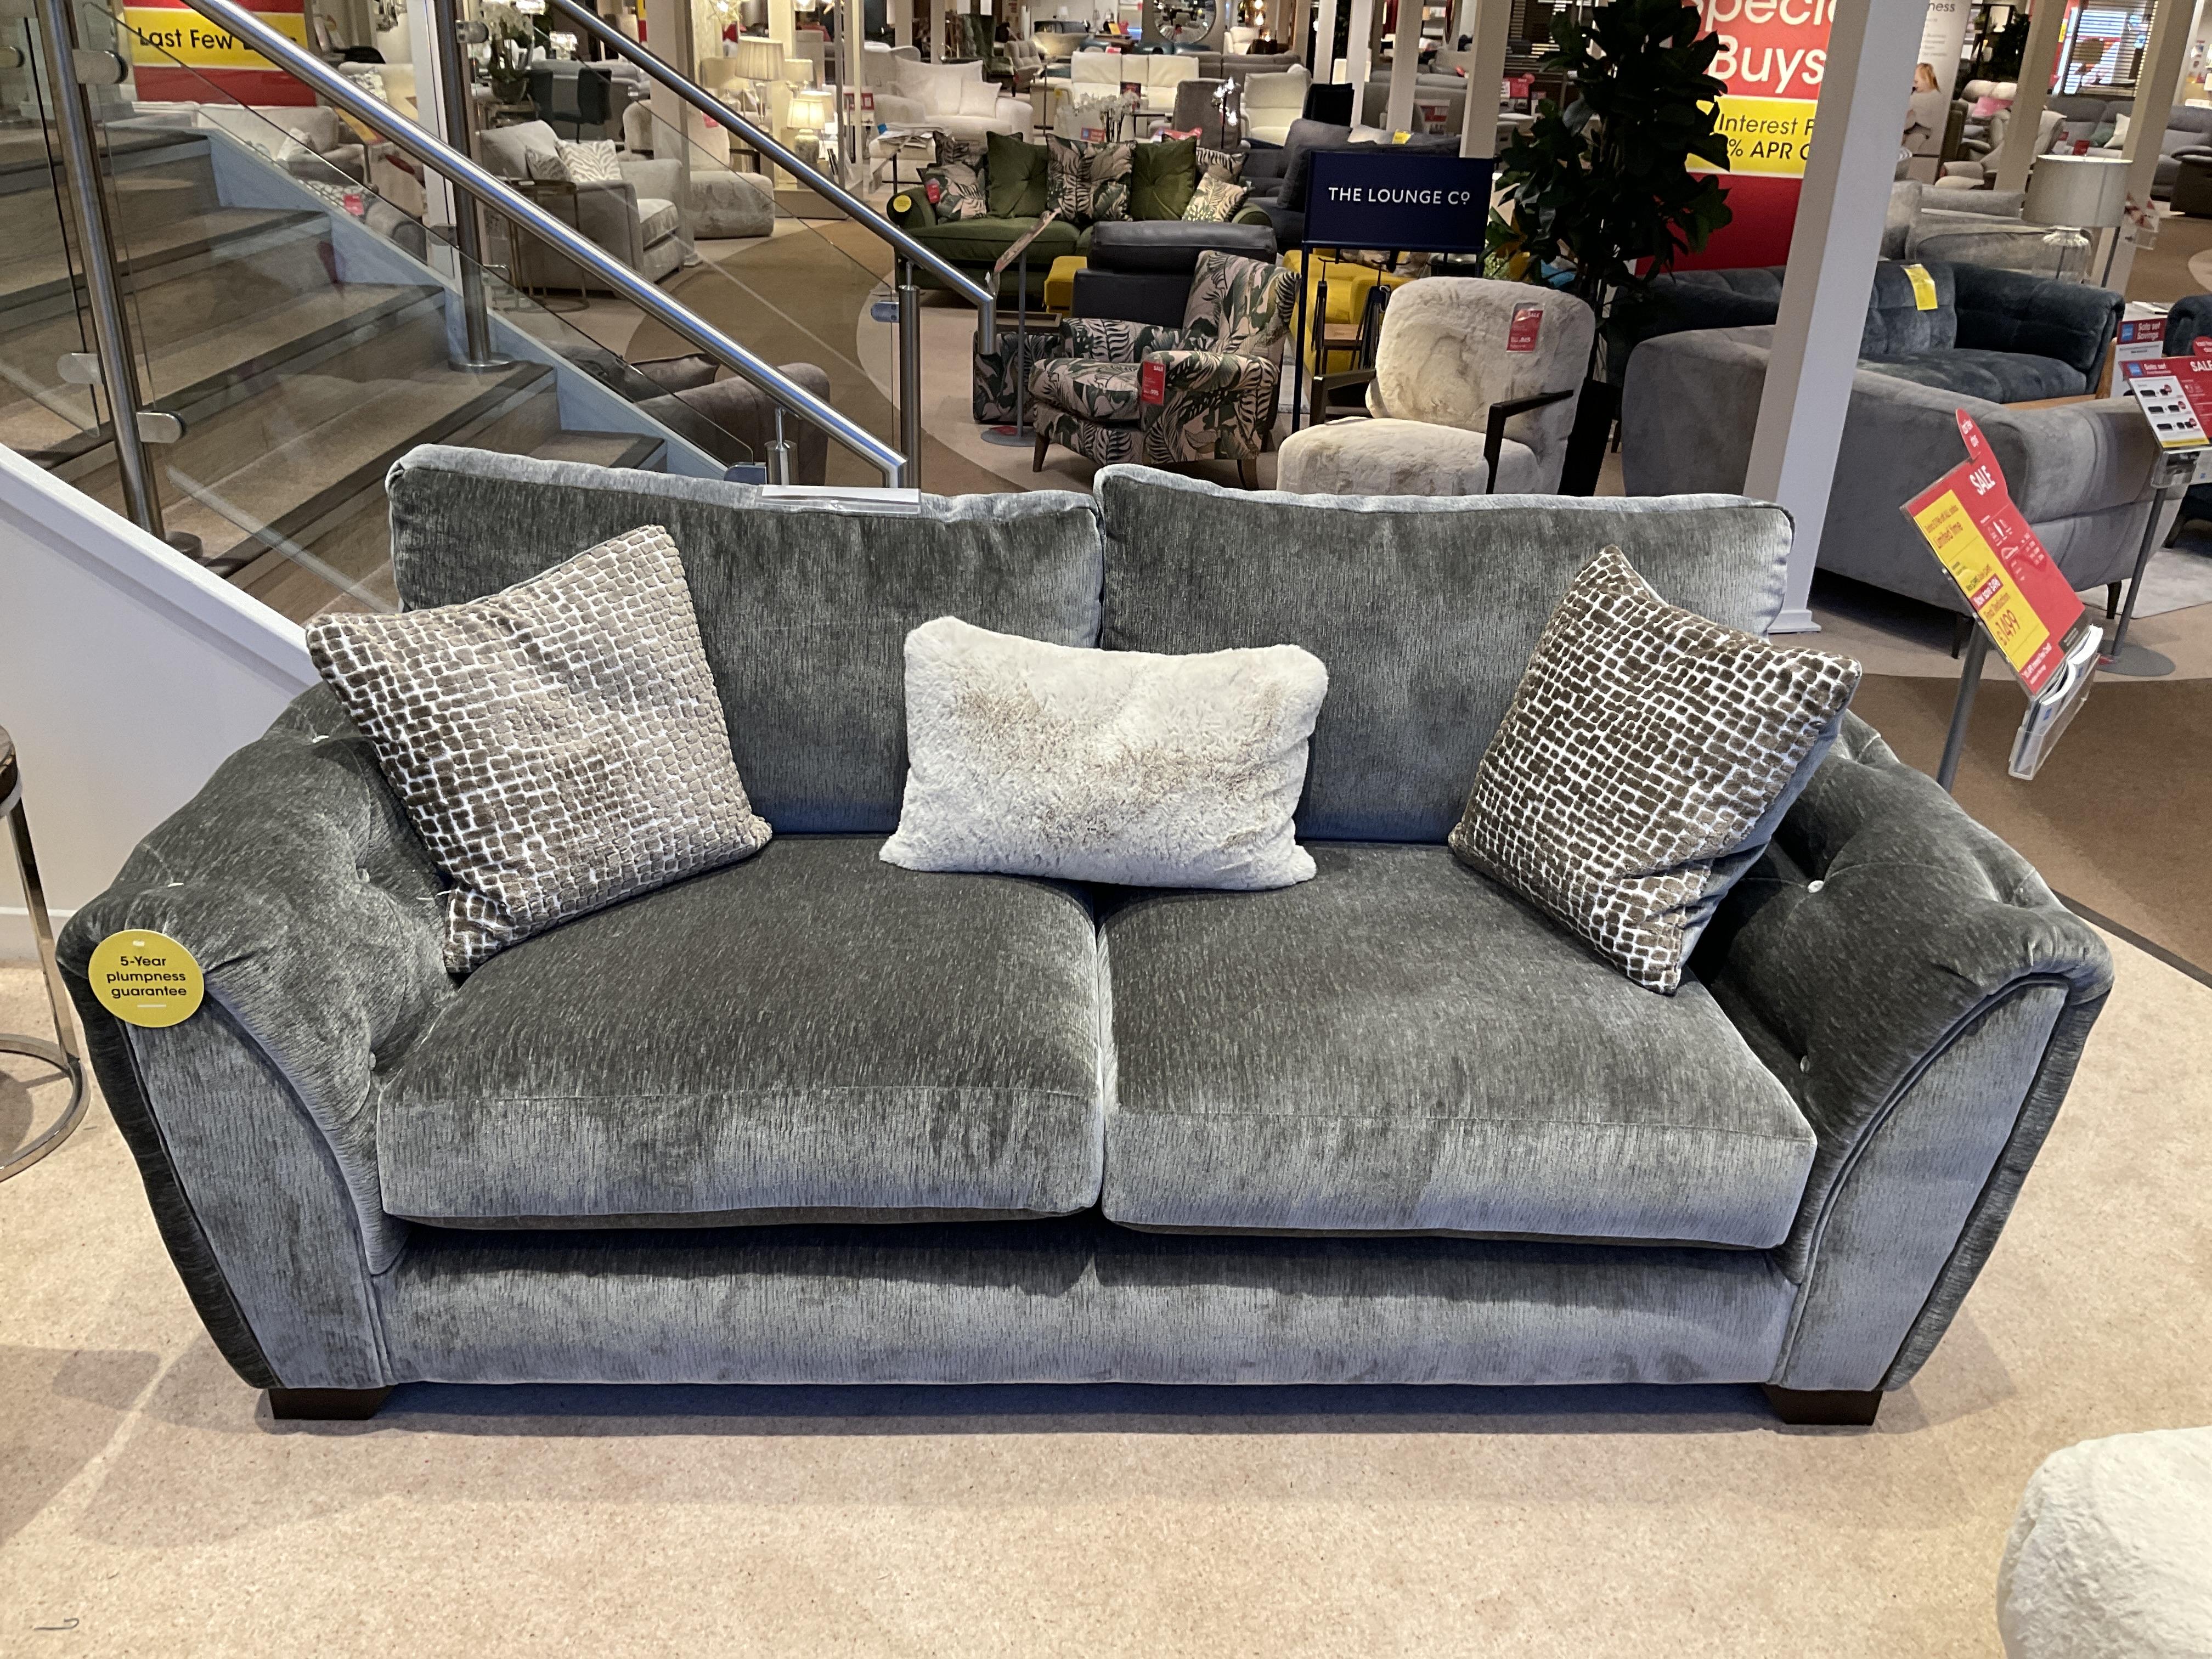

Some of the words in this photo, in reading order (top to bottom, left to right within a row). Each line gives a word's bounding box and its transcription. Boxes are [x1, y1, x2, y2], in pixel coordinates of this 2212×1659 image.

[1699, 0, 1836, 32] peci
[138, 27, 182, 48] Last
[190, 29, 233, 50] Few
[1708, 35, 1827, 94] Buys
[1718, 113, 1798, 135] Interest
[1749, 140, 1793, 160] APR
[1328, 187, 1362, 201] THE
[1368, 189, 1442, 204] LOUNGE
[1970, 465, 1996, 495] SALE
[1995, 609, 2021, 646] £1499
[120, 956, 166, 966] 5-Year
[106, 972, 186, 984] plumpness
[111, 986, 187, 999] guarantee
